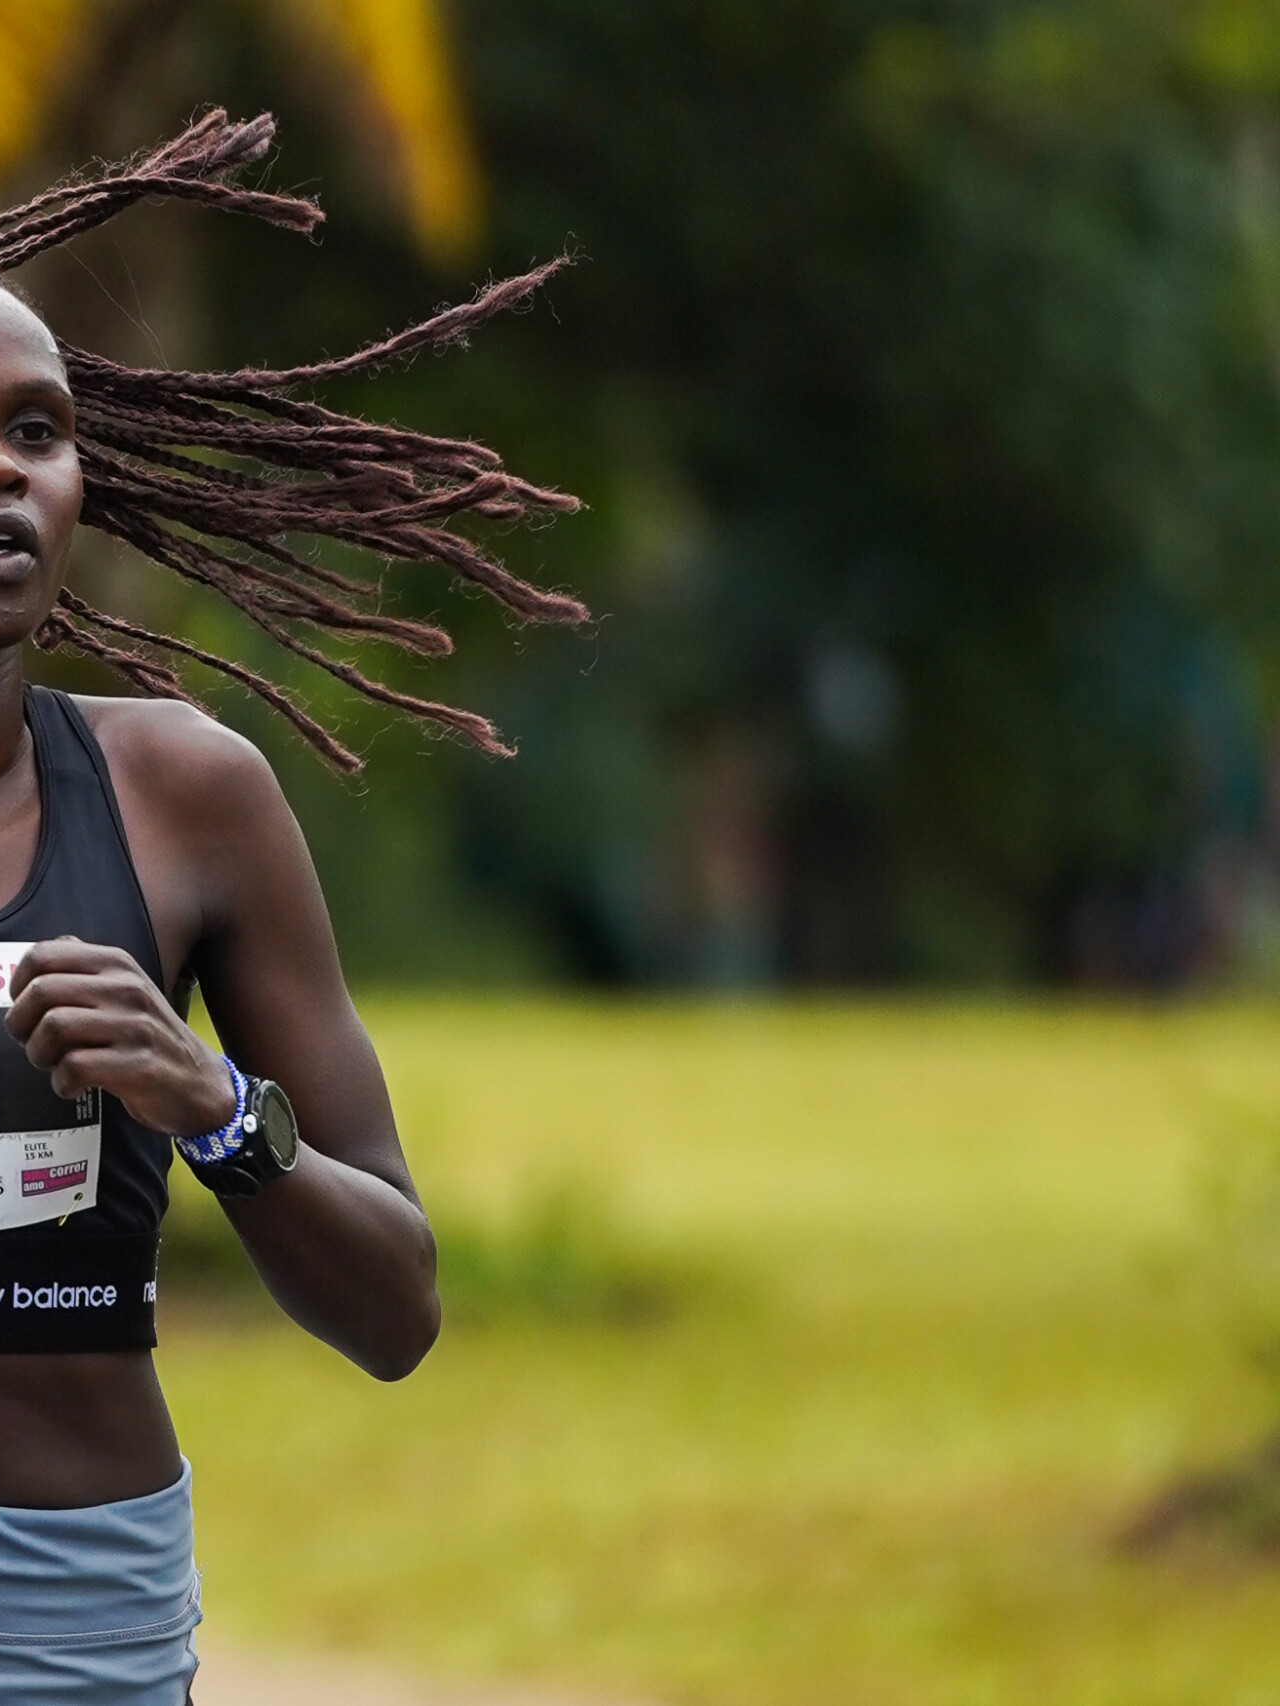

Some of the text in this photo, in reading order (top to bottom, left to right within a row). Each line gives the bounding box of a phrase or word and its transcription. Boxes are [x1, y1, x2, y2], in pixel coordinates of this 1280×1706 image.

[24, 1142, 48, 1152] ELITE
[25, 1150, 54, 1160] 15 KM
[49, 1161, 87, 1178] correr
[13, 1282, 118, 1309] balance
